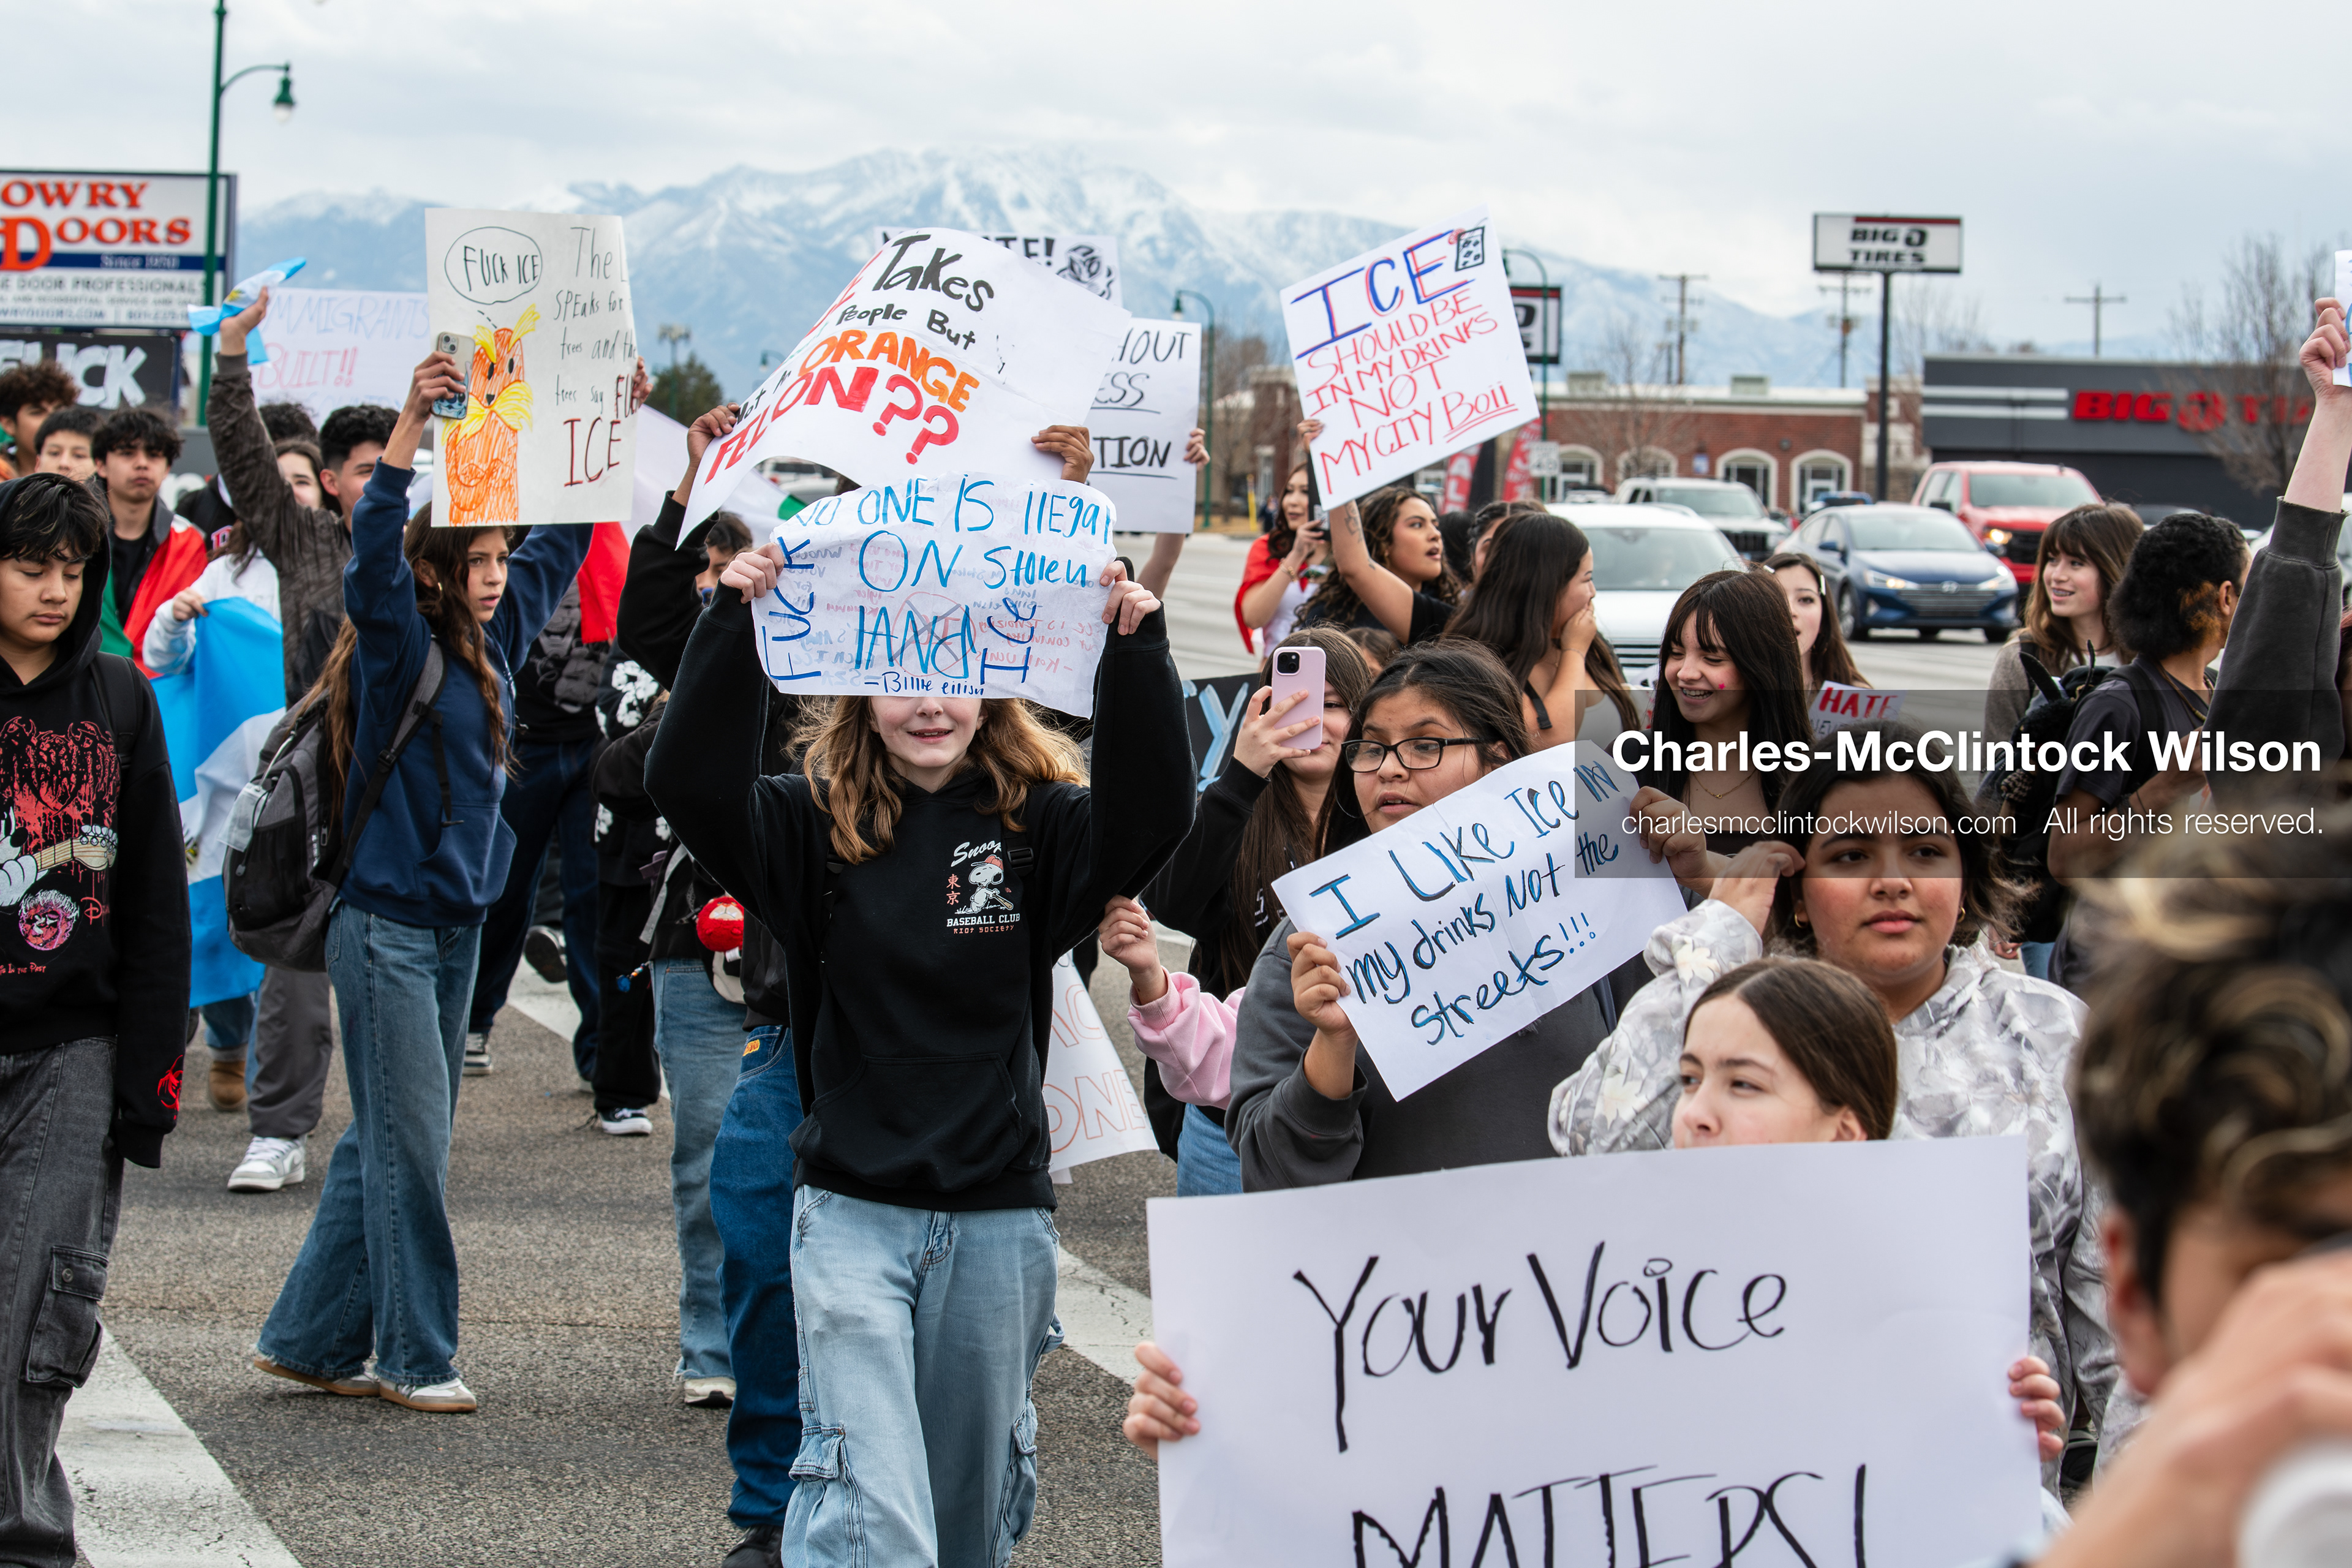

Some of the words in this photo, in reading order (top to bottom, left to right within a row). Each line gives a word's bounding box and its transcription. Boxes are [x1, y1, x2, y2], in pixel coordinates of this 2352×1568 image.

[2, 216, 192, 271] DOORS
[570, 227, 612, 279] The
[1850, 249, 1925, 263] TIRES
[1851, 228, 1898, 242] BIG
[464, 246, 508, 292] FUCK
[517, 255, 538, 284] ICE
[872, 235, 994, 312] Takes
[1291, 229, 1476, 360] ICE
[609, 291, 623, 312] for
[560, 326, 582, 360] trees
[591, 330, 619, 363] and
[927, 309, 975, 350] But
[1308, 314, 1428, 393] SHOULD
[1431, 288, 1483, 326] BE
[798, 329, 980, 414] ORANGE
[1306, 376, 1353, 417] IN
[1357, 355, 1393, 391] MY
[1401, 311, 1498, 371] DRINKS
[556, 374, 577, 406] trees
[590, 385, 603, 415] say
[1349, 356, 1449, 428] NOT
[2074, 391, 2173, 421] BIG
[564, 417, 622, 487] ICE
[1321, 432, 1371, 494] MY
[1374, 402, 1434, 457] CITY
[858, 478, 934, 527] ONE
[859, 530, 963, 592] ON
[1818, 687, 1898, 719] HATE
[946, 873, 961, 906] 東京
[1309, 874, 1381, 939] I
[946, 914, 995, 927] BASEBALL
[998, 913, 1021, 922] CLUB
[979, 924, 1014, 933] SOCIETY
[1346, 941, 1411, 1005] my
[1413, 892, 1496, 970] drinks
[1576, 831, 1619, 875] the
[1294, 1254, 1512, 1453] Your
[1528, 1242, 1787, 1370] Voice
